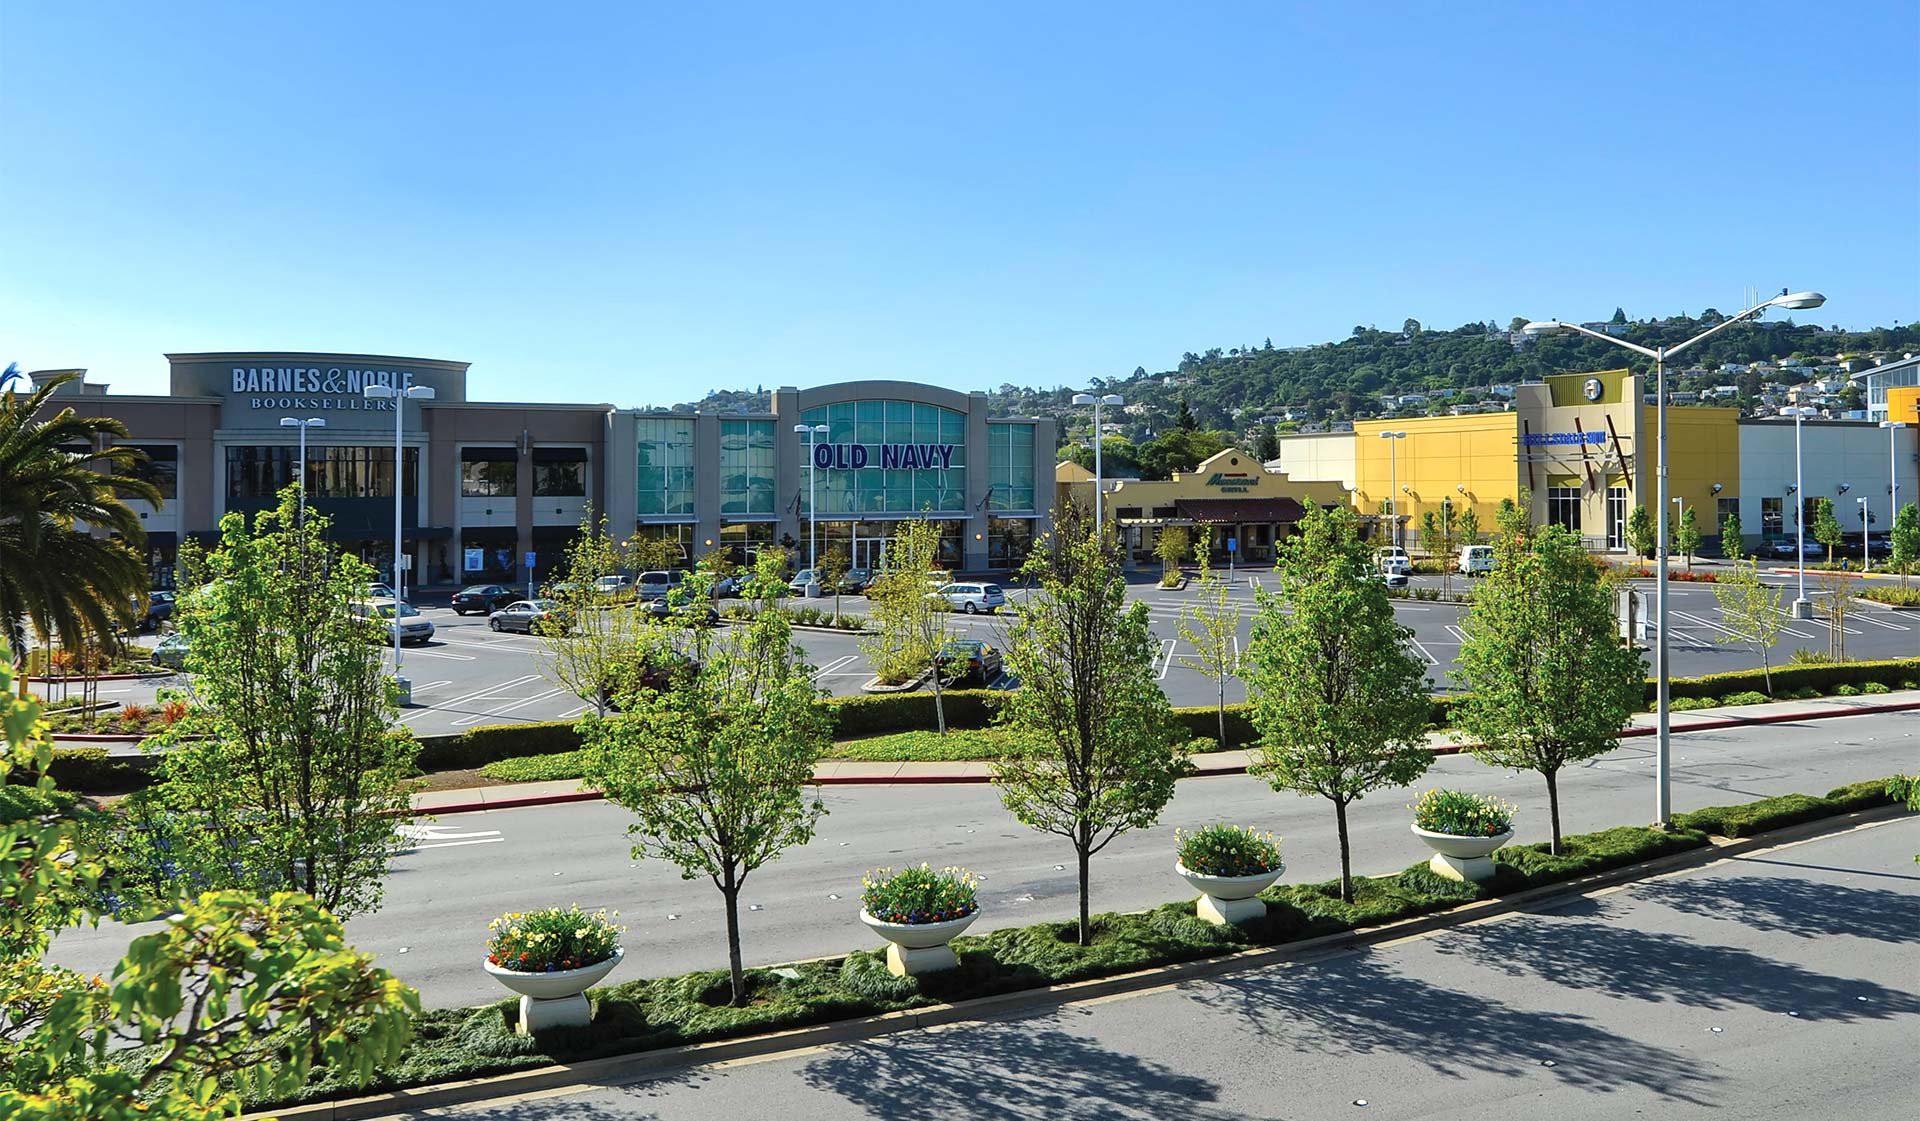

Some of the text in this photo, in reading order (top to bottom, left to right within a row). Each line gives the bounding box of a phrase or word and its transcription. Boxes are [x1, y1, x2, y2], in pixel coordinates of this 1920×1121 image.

[252, 398, 397, 411] BOOKSELLERS
[813, 443, 954, 470] OLD NAVY
